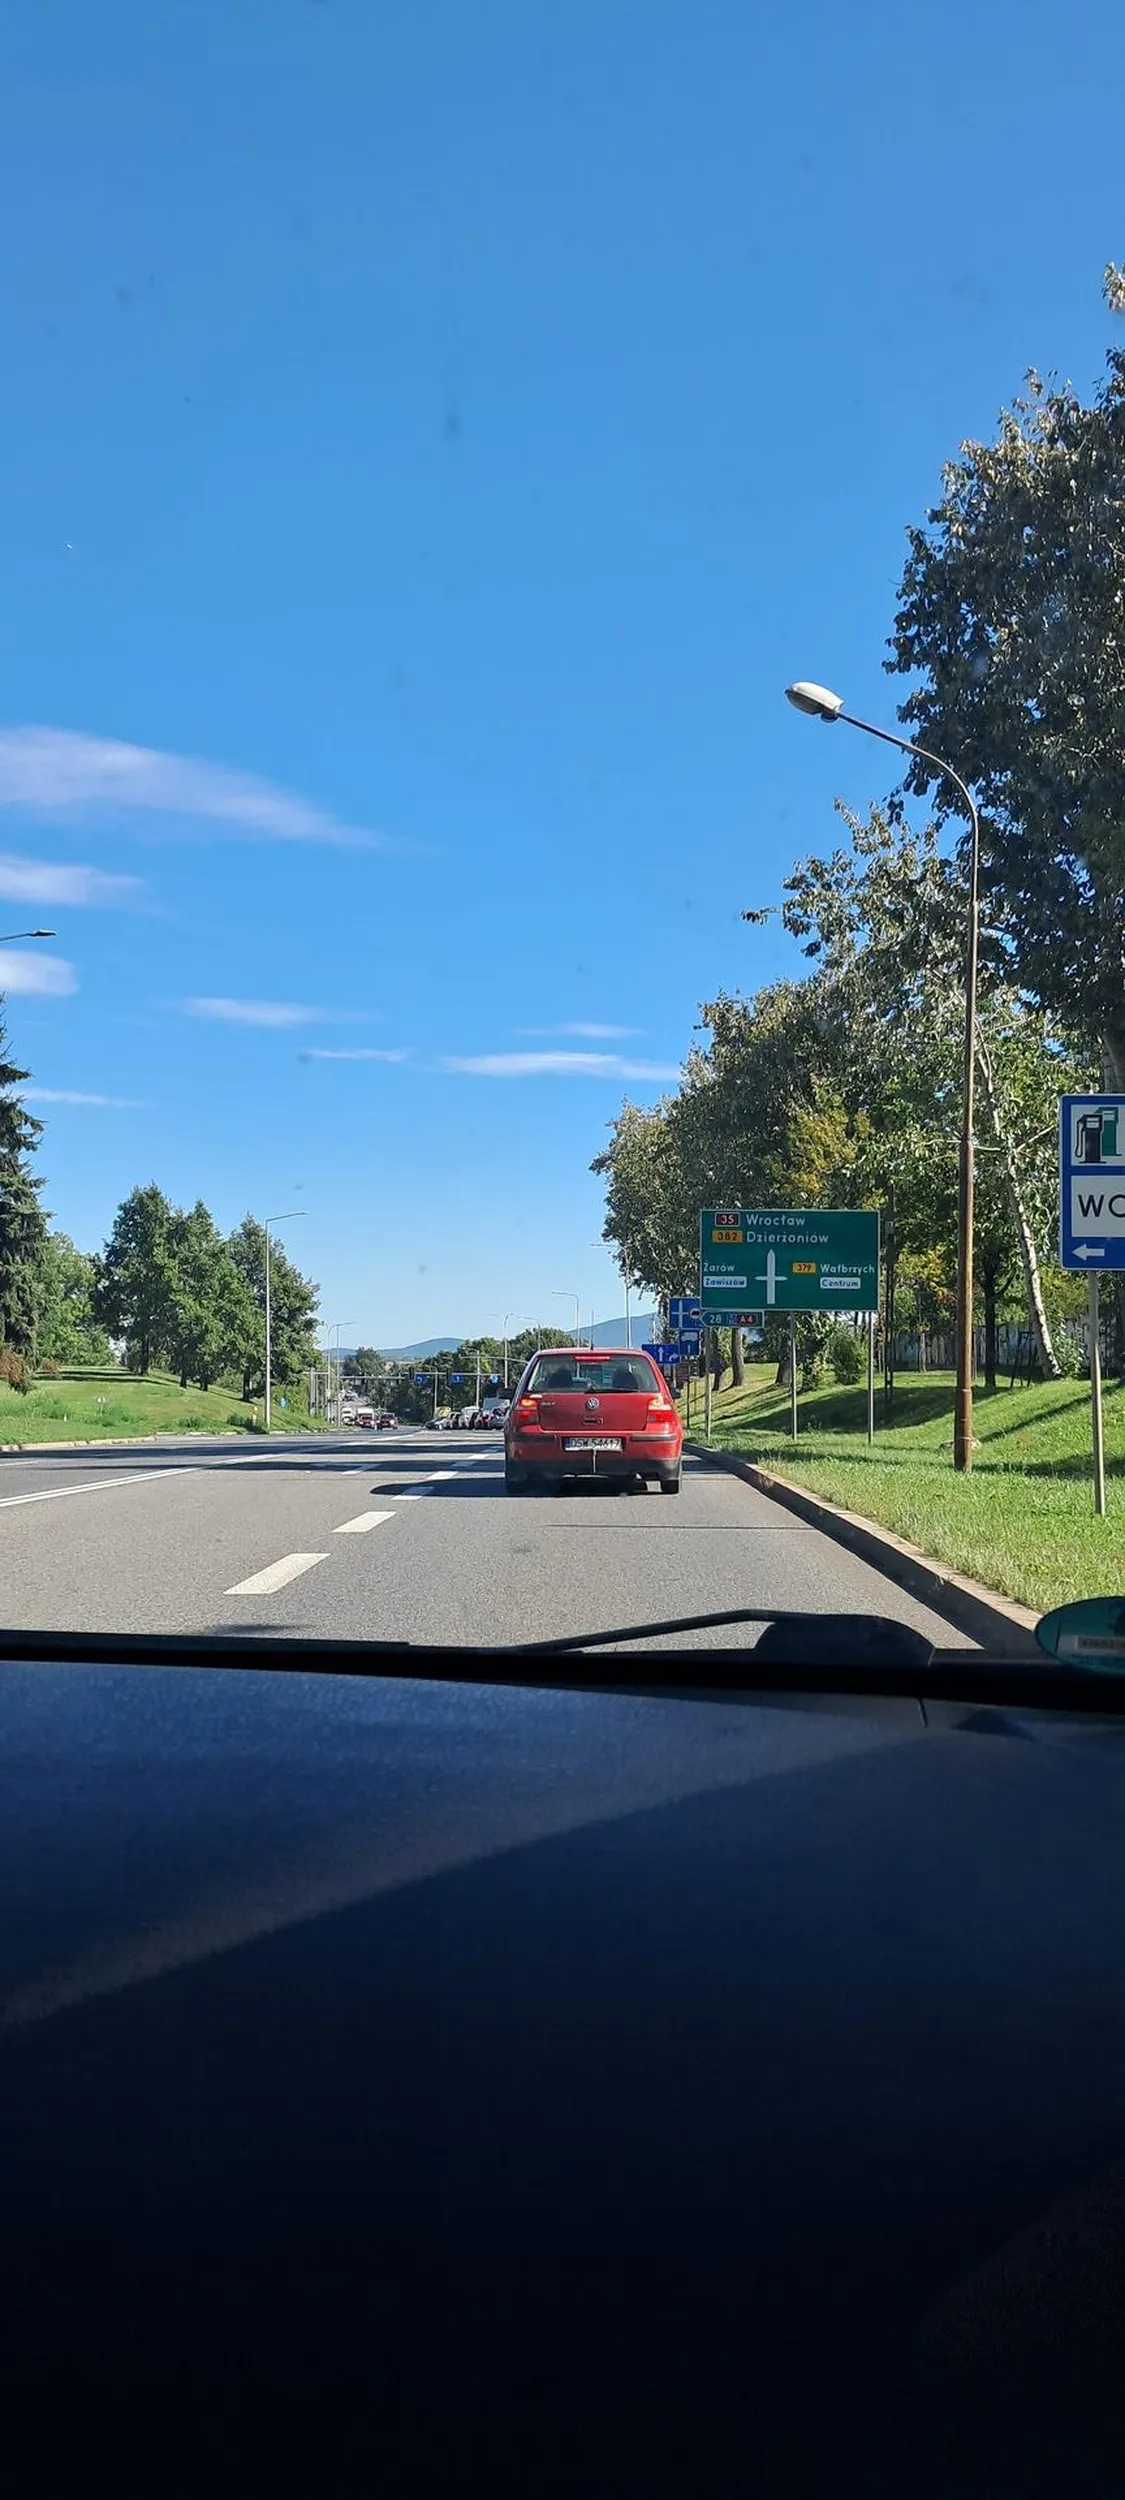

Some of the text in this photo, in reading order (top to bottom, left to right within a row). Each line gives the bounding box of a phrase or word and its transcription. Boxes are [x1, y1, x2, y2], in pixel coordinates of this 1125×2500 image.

[720, 1214, 735, 1225] 35
[746, 1213, 806, 1226] Wrocław
[746, 1229, 829, 1243] Dzierżoniów
[703, 1259, 735, 1272] Żarów
[796, 1264, 812, 1272] 379
[820, 1263, 875, 1276] Wałbrzych
[821, 1278, 859, 1288] Centrum
[709, 1315, 722, 1324] 28
